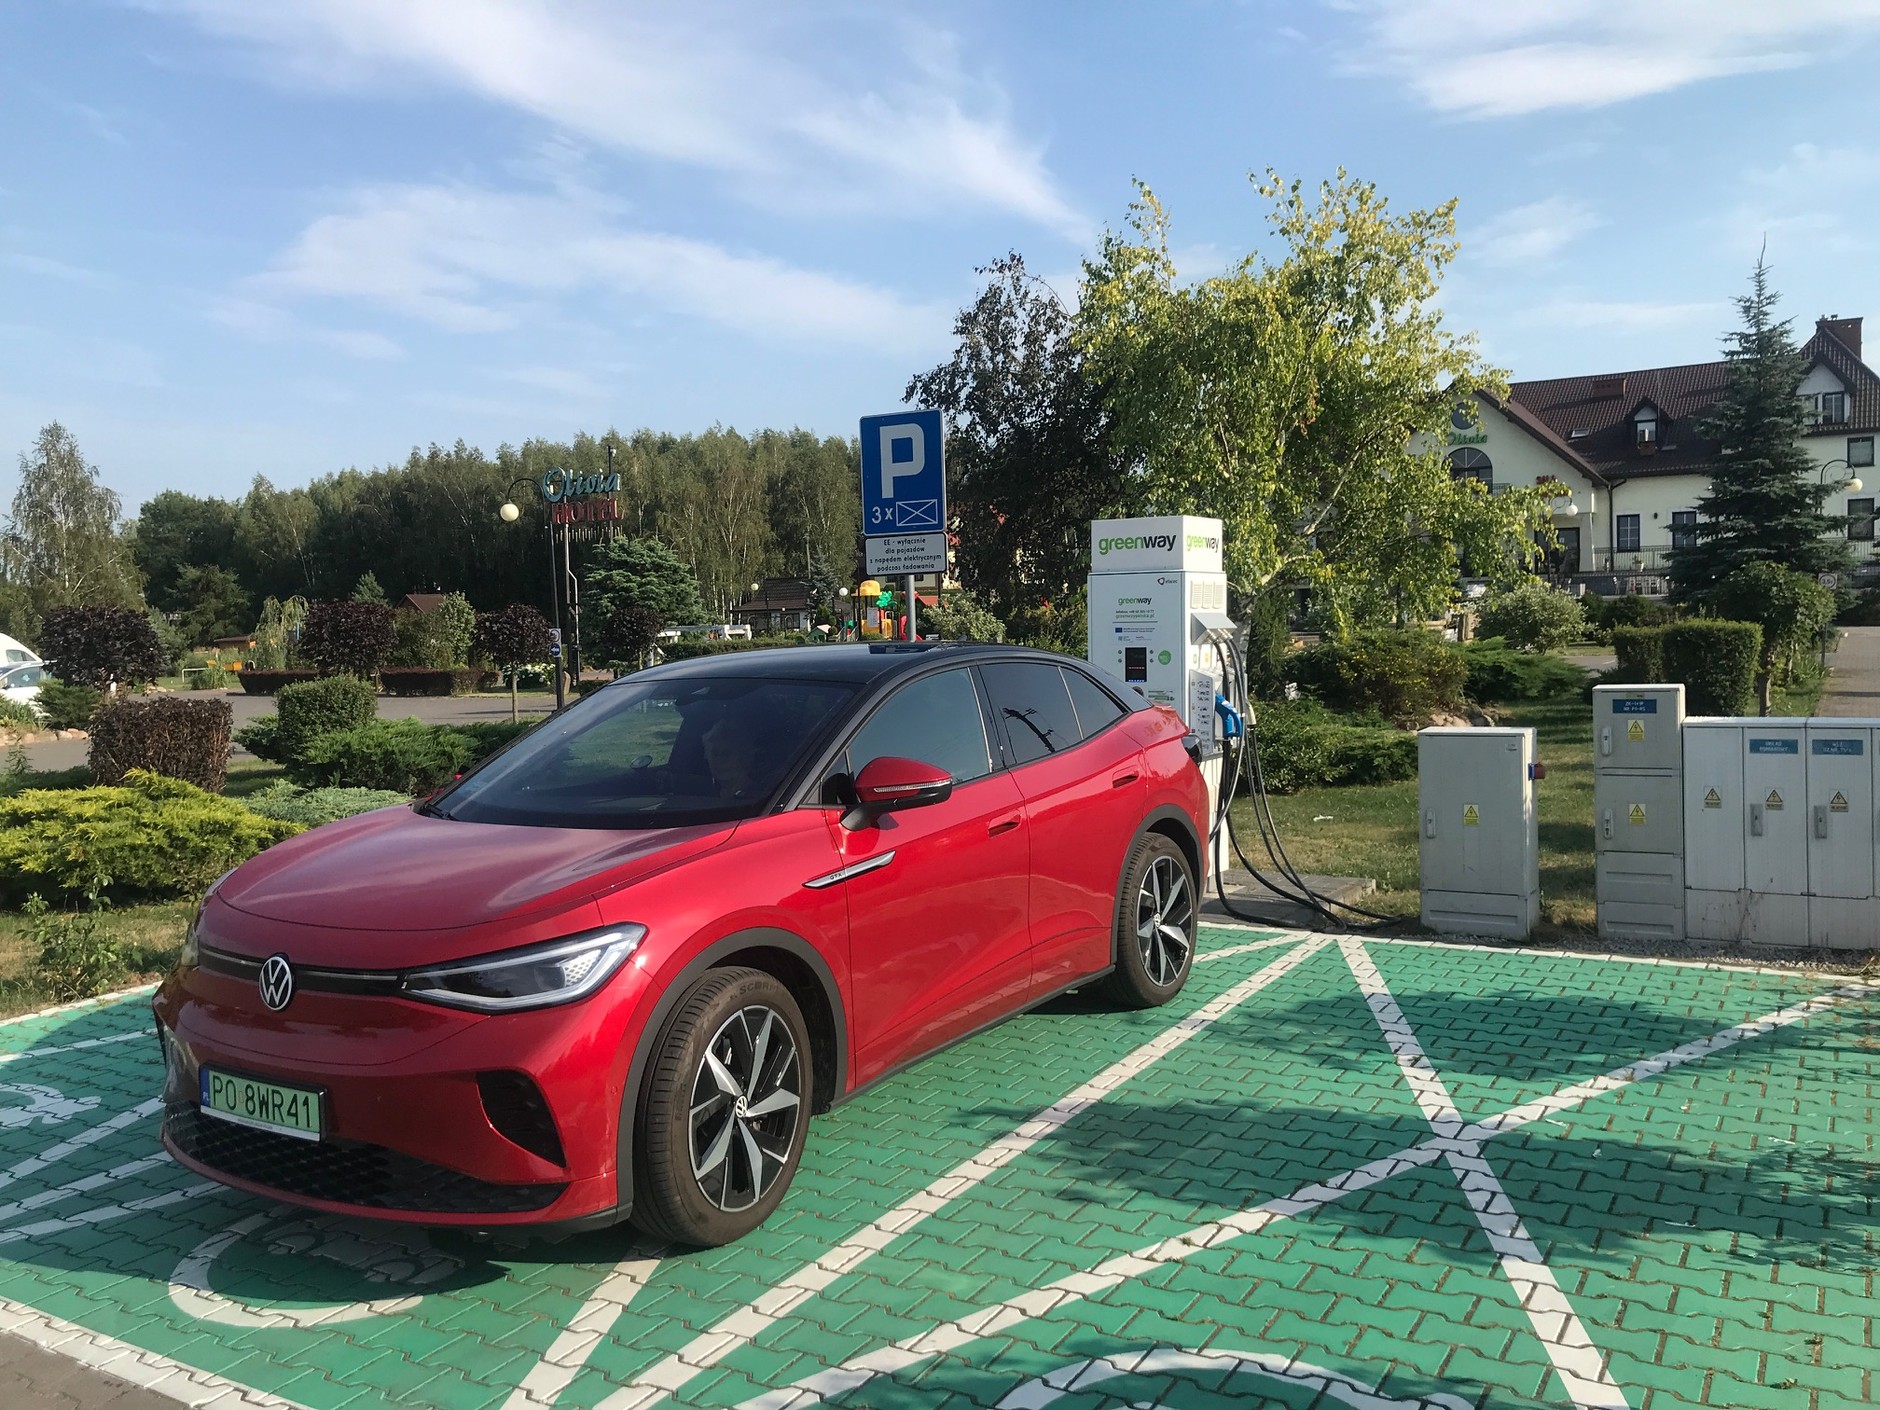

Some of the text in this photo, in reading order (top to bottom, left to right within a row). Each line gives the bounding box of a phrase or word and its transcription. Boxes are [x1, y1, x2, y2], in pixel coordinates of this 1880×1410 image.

[879, 423, 925, 499] P
[543, 466, 620, 502] Olivia
[552, 498, 624, 524] HOTEL
[897, 538, 926, 546] wyłącznie
[897, 546, 925, 556] pojazdów
[1098, 534, 1177, 555] greenway
[1186, 534, 1220, 553] greenway
[874, 555, 902, 564] napędem
[903, 553, 942, 563] elektrycznym
[877, 562, 935, 573] podczas ładowania
[1118, 597, 1152, 606] greenway
[212, 1074, 310, 1128] PO 8WR41
